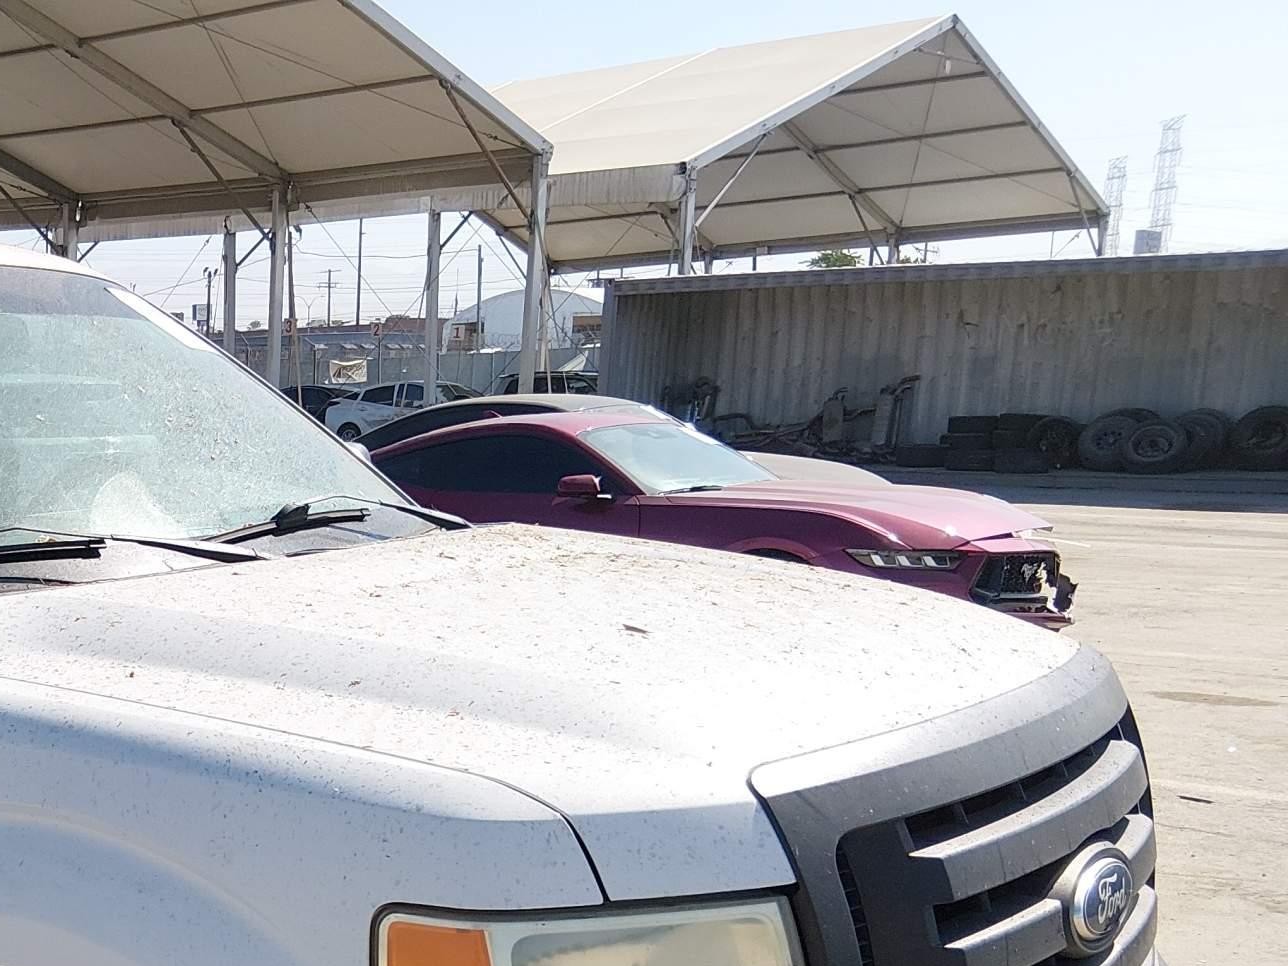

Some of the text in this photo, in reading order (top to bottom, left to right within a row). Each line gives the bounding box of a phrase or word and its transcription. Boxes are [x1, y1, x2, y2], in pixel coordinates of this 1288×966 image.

[285, 320, 292, 333] 3
[373, 324, 380, 336] 2
[1098, 872, 1127, 924] Ford
